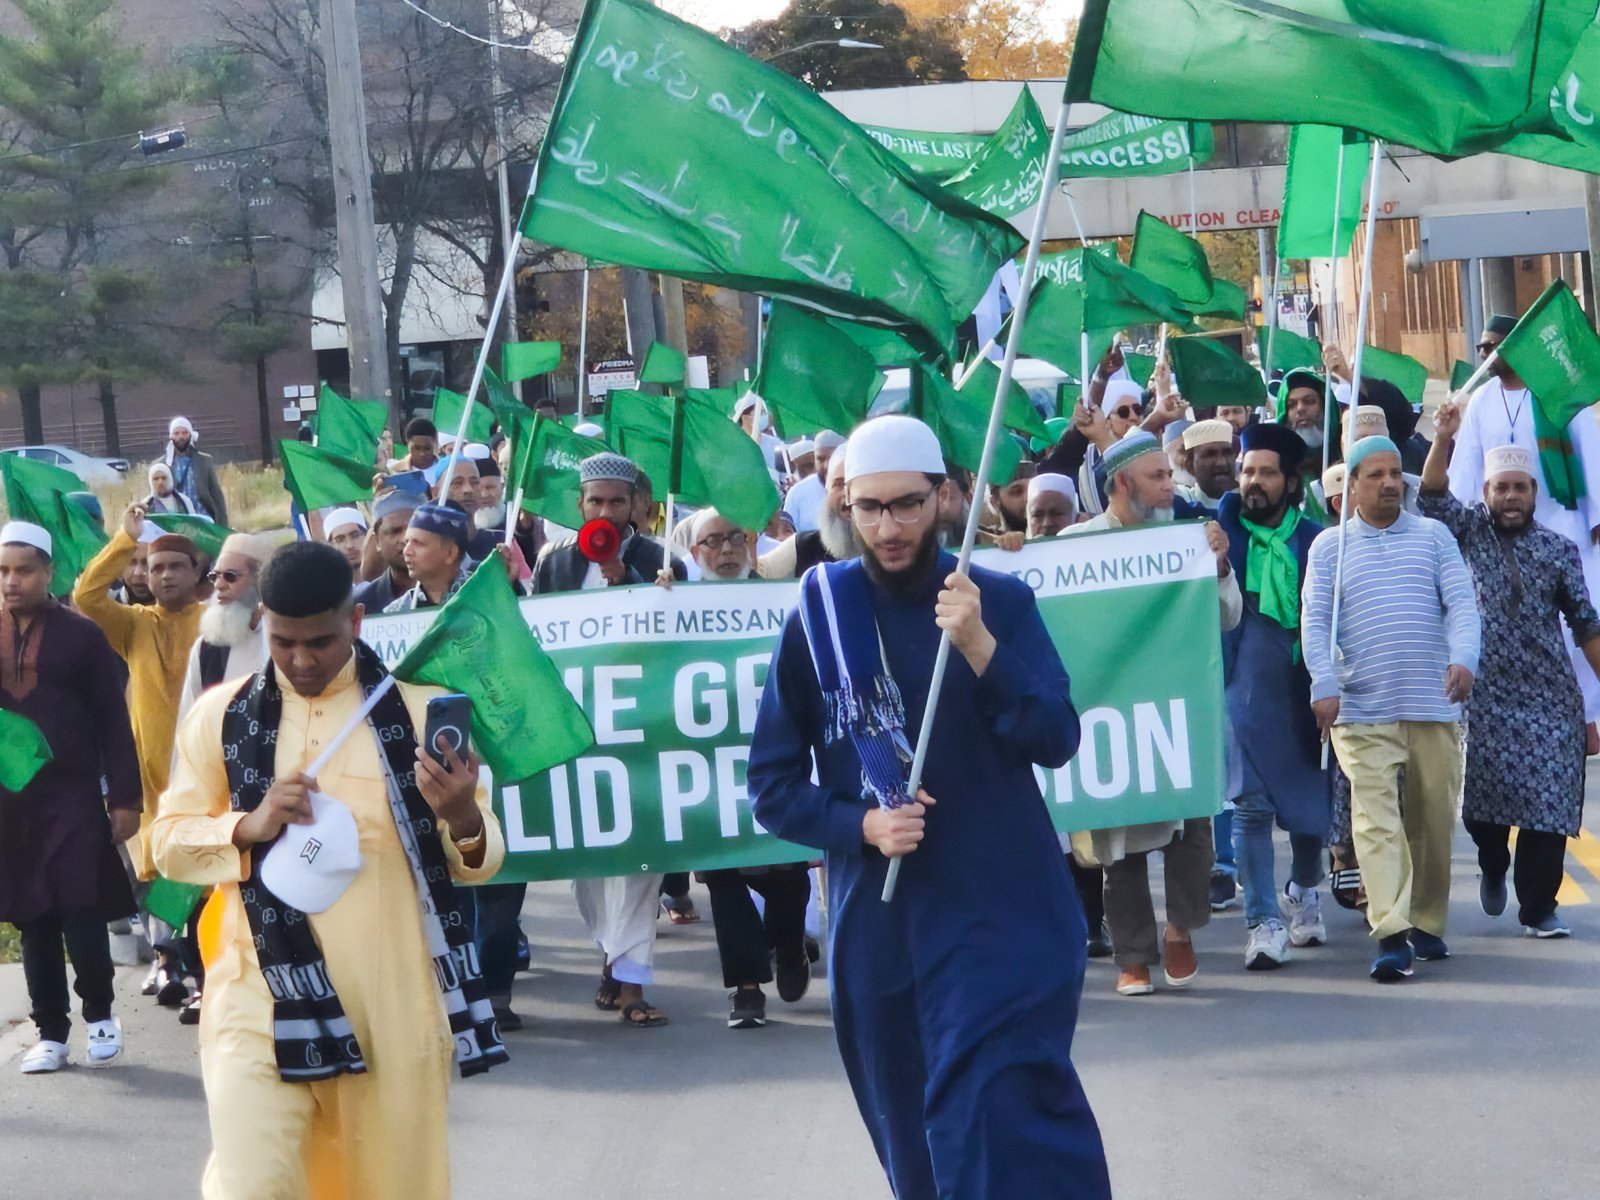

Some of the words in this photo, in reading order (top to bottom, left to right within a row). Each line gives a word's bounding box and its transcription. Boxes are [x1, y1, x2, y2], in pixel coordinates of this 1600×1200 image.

[931, 141, 971, 160] LAST
[366, 621, 411, 639] UPON
[579, 616, 613, 639] OF
[622, 610, 666, 635] THE
